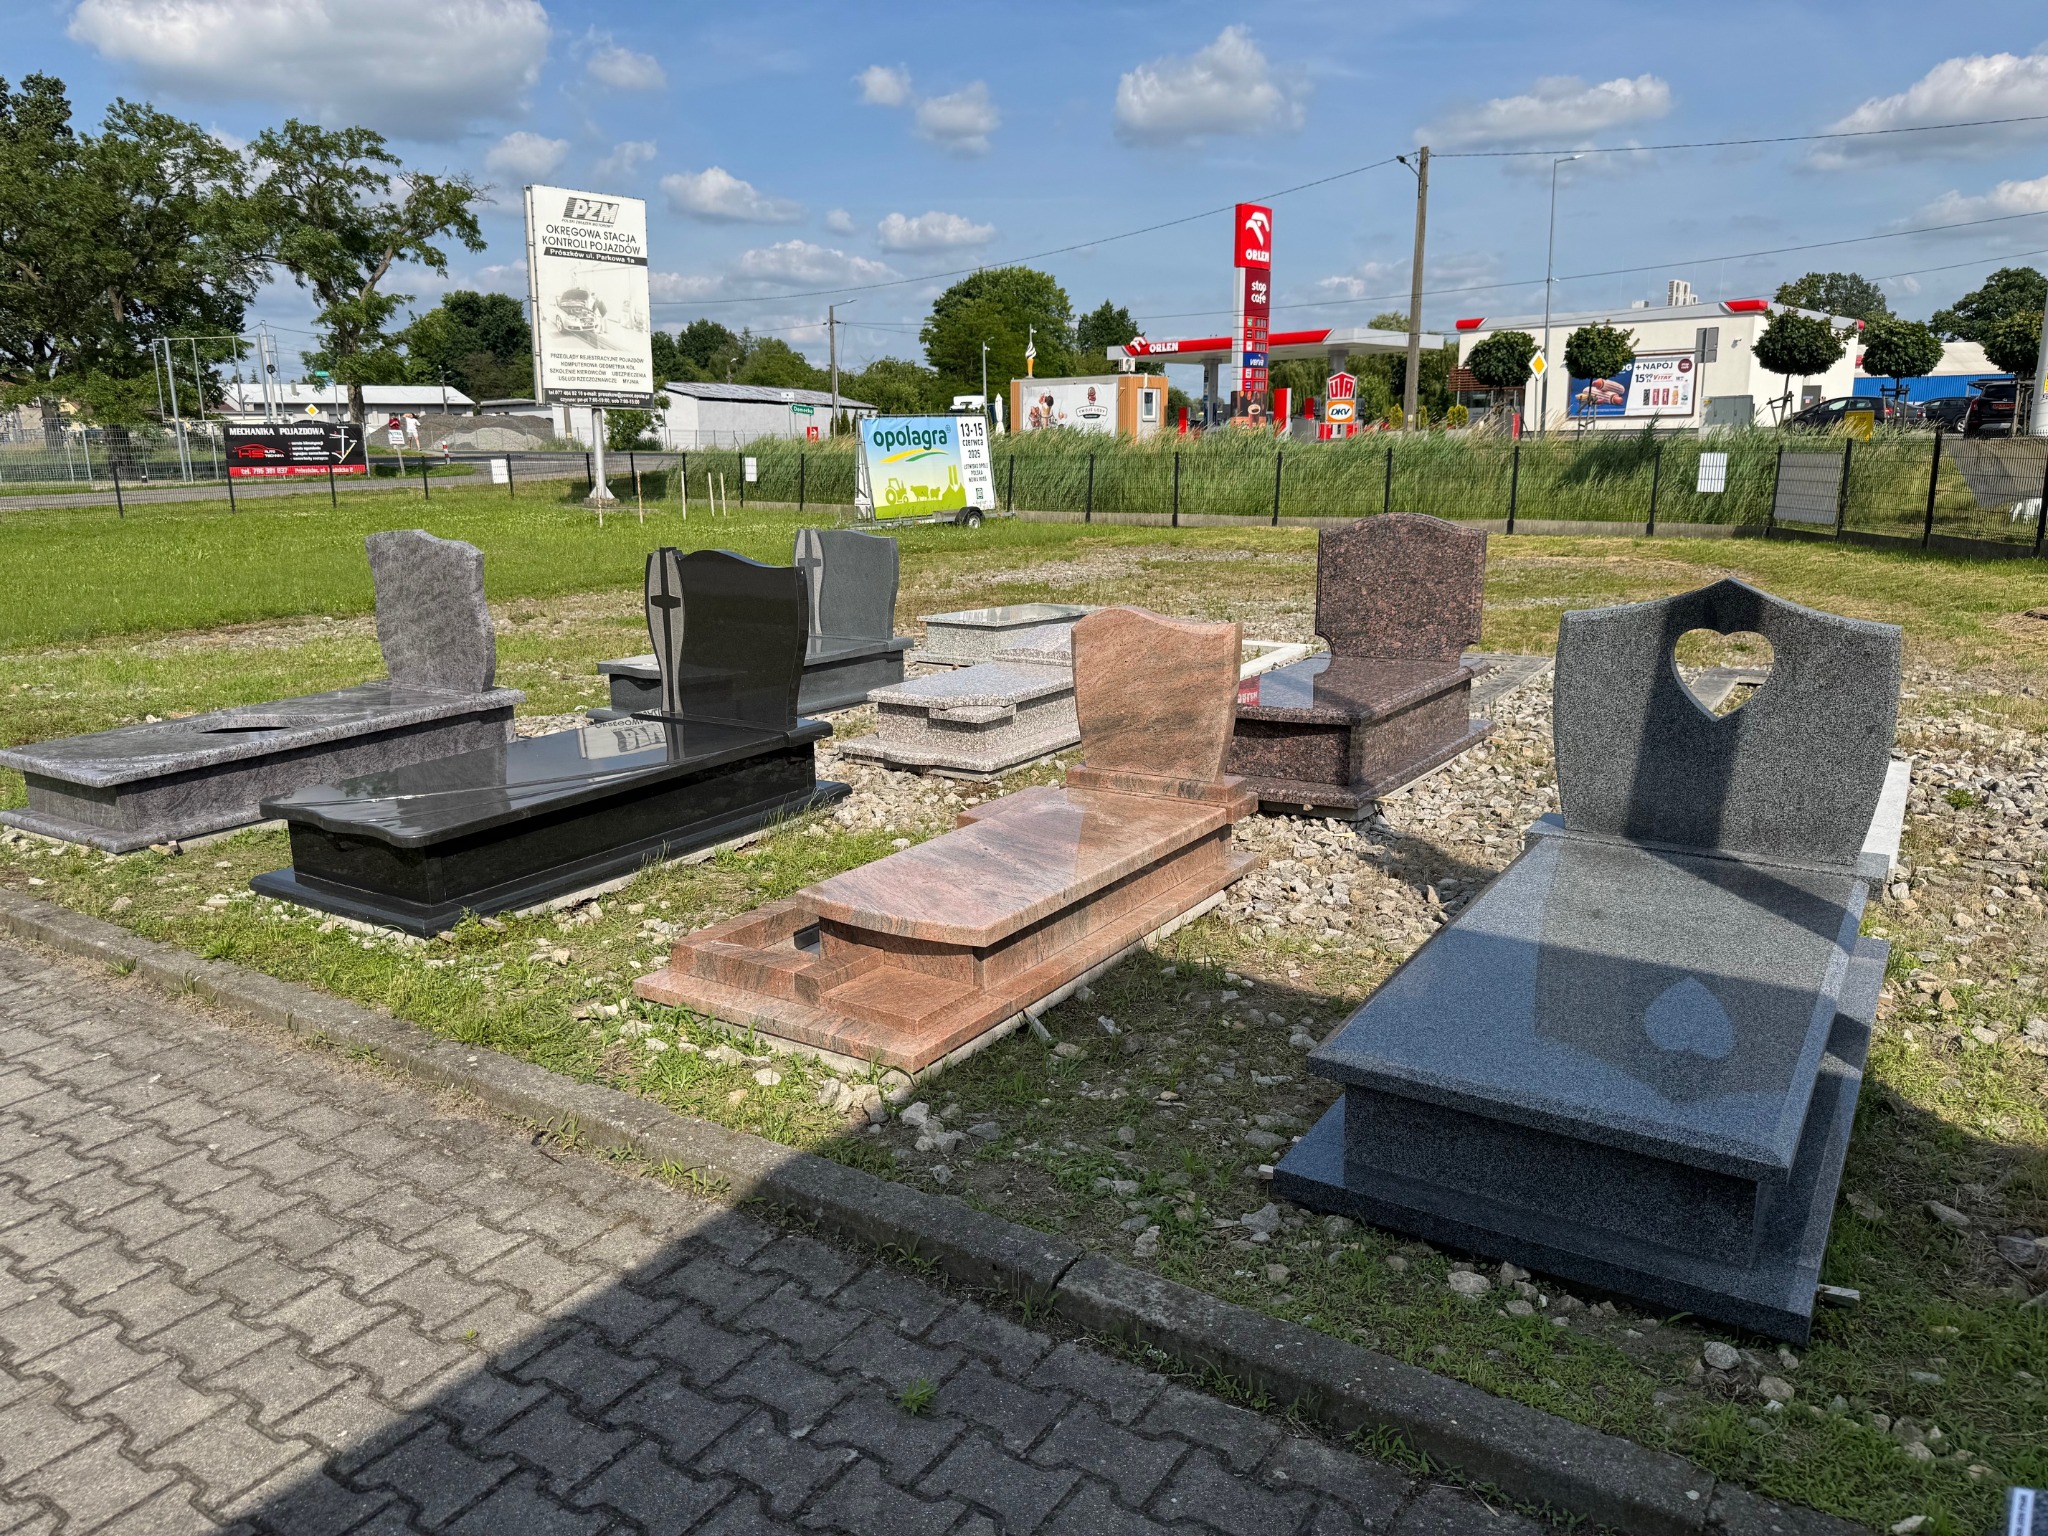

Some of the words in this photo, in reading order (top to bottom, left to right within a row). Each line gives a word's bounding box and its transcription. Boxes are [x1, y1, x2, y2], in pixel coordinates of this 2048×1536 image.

[571, 198, 619, 224] PZM
[546, 224, 601, 239] OKRĘGOWA
[603, 231, 636, 244] STACJA
[542, 235, 587, 249] KONTROLI
[590, 242, 641, 255] POJAZDÓW
[586, 251, 595, 259] ul.
[596, 253, 626, 263] Parkowa
[627, 256, 635, 264] 1a
[1245, 248, 1270, 262] ORLEN
[1251, 280, 1267, 294] stop
[1149, 341, 1179, 353] ORLEN
[1643, 361, 1673, 370] NAPÓJ
[1329, 377, 1355, 399] UTA
[1330, 408, 1351, 416] DKV
[229, 427, 275, 436] MECHANIKA
[279, 427, 325, 435] POJAZDOWA
[960, 423, 983, 437] 13-15
[873, 425, 948, 452] opolagra
[962, 438, 984, 447] czerwca
[968, 450, 981, 459] 2025
